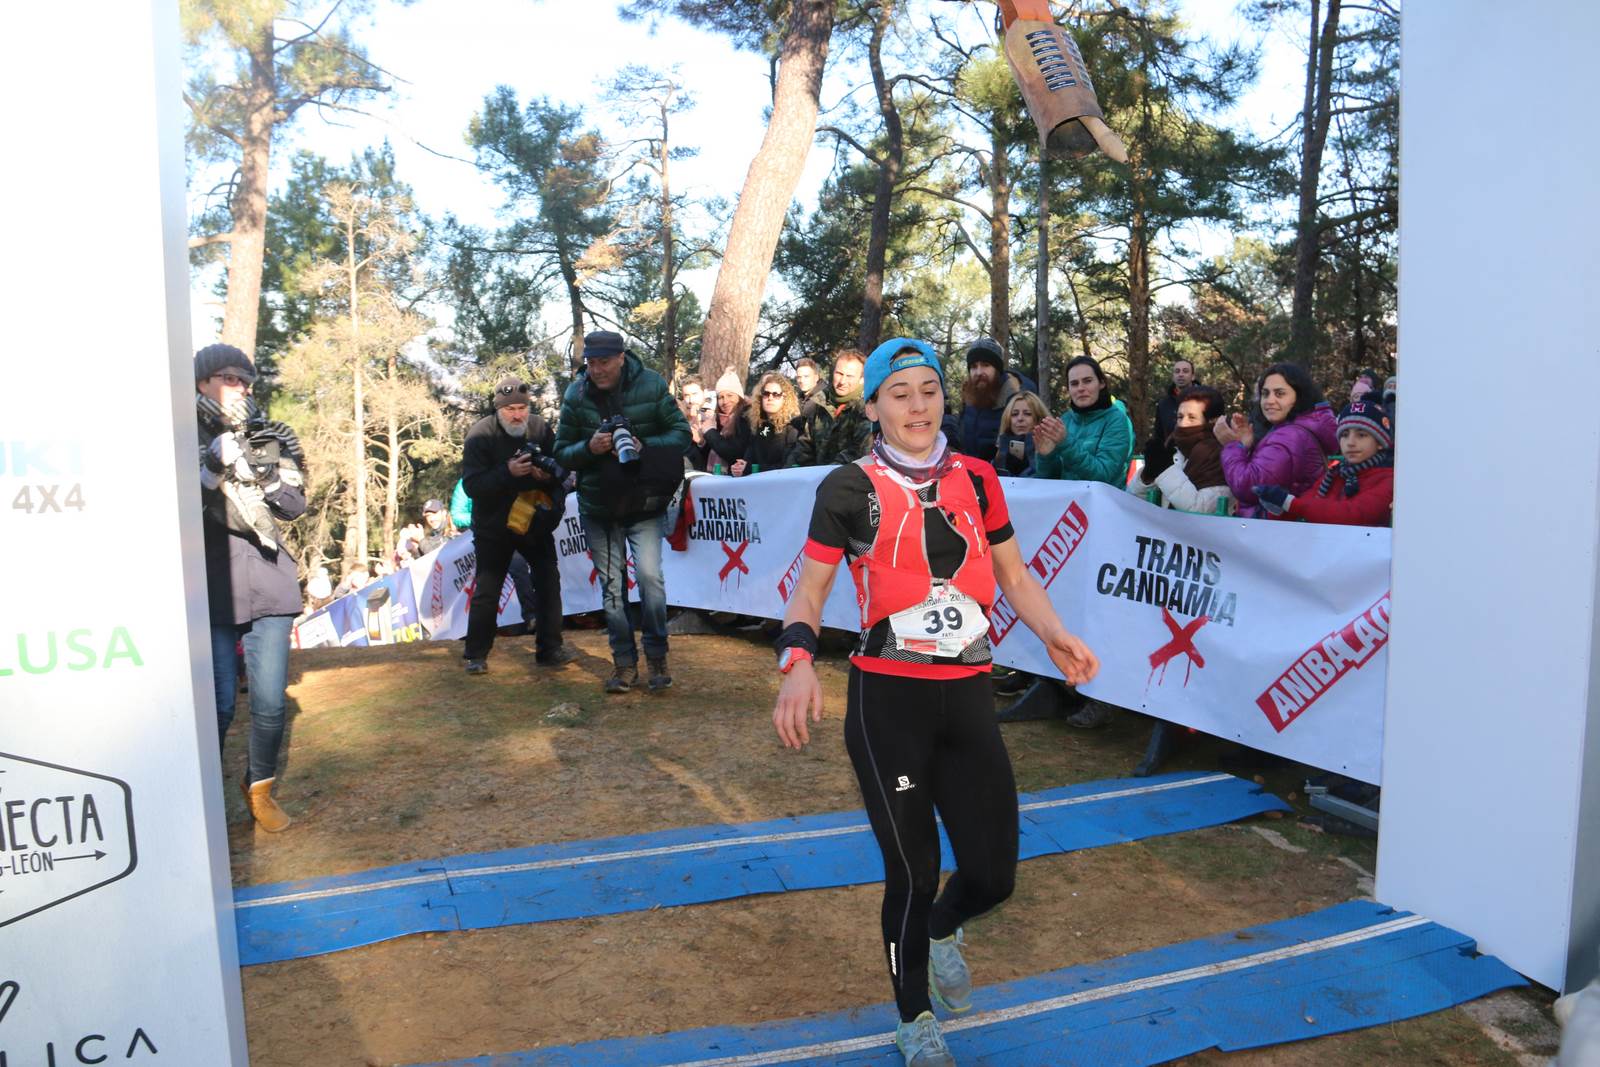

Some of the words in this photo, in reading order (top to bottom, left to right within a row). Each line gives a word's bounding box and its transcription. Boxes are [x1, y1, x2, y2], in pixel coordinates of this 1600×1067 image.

[12, 483, 86, 514] 4X4
[699, 497, 748, 521] TRANS
[688, 519, 762, 544] CANDAMIA
[1136, 535, 1221, 586] TRANS
[1096, 562, 1237, 627] CANDAMIA
[922, 606, 963, 635] 39
